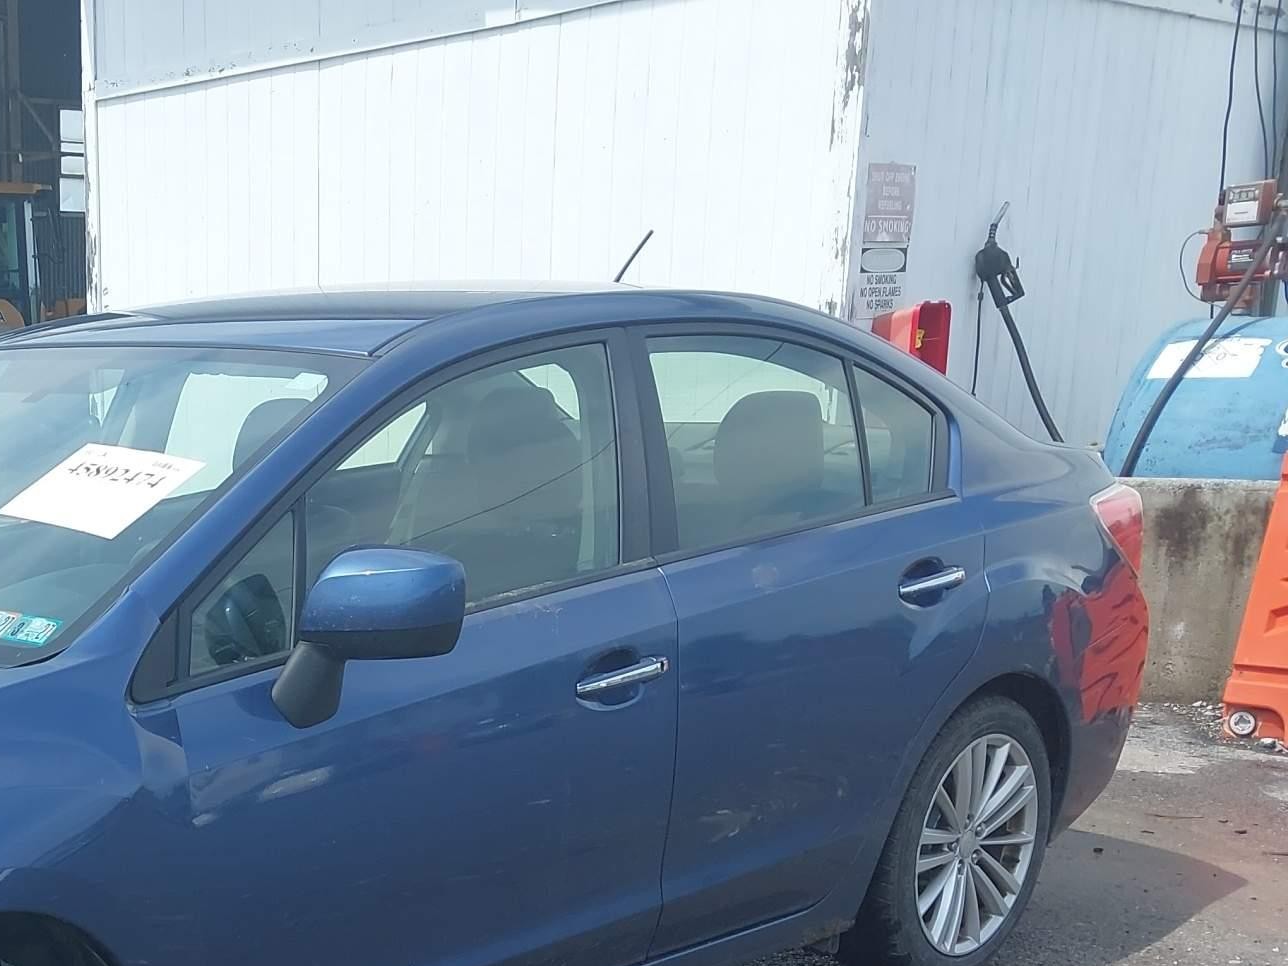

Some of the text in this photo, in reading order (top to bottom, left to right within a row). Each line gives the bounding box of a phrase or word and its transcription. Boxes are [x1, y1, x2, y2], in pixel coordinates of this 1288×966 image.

[864, 220, 910, 233] NO SMOKING
[866, 274, 897, 285] NO SMOKING
[860, 286, 902, 297] NO OPEN FLAMES
[866, 299, 894, 310] NO SPARKS
